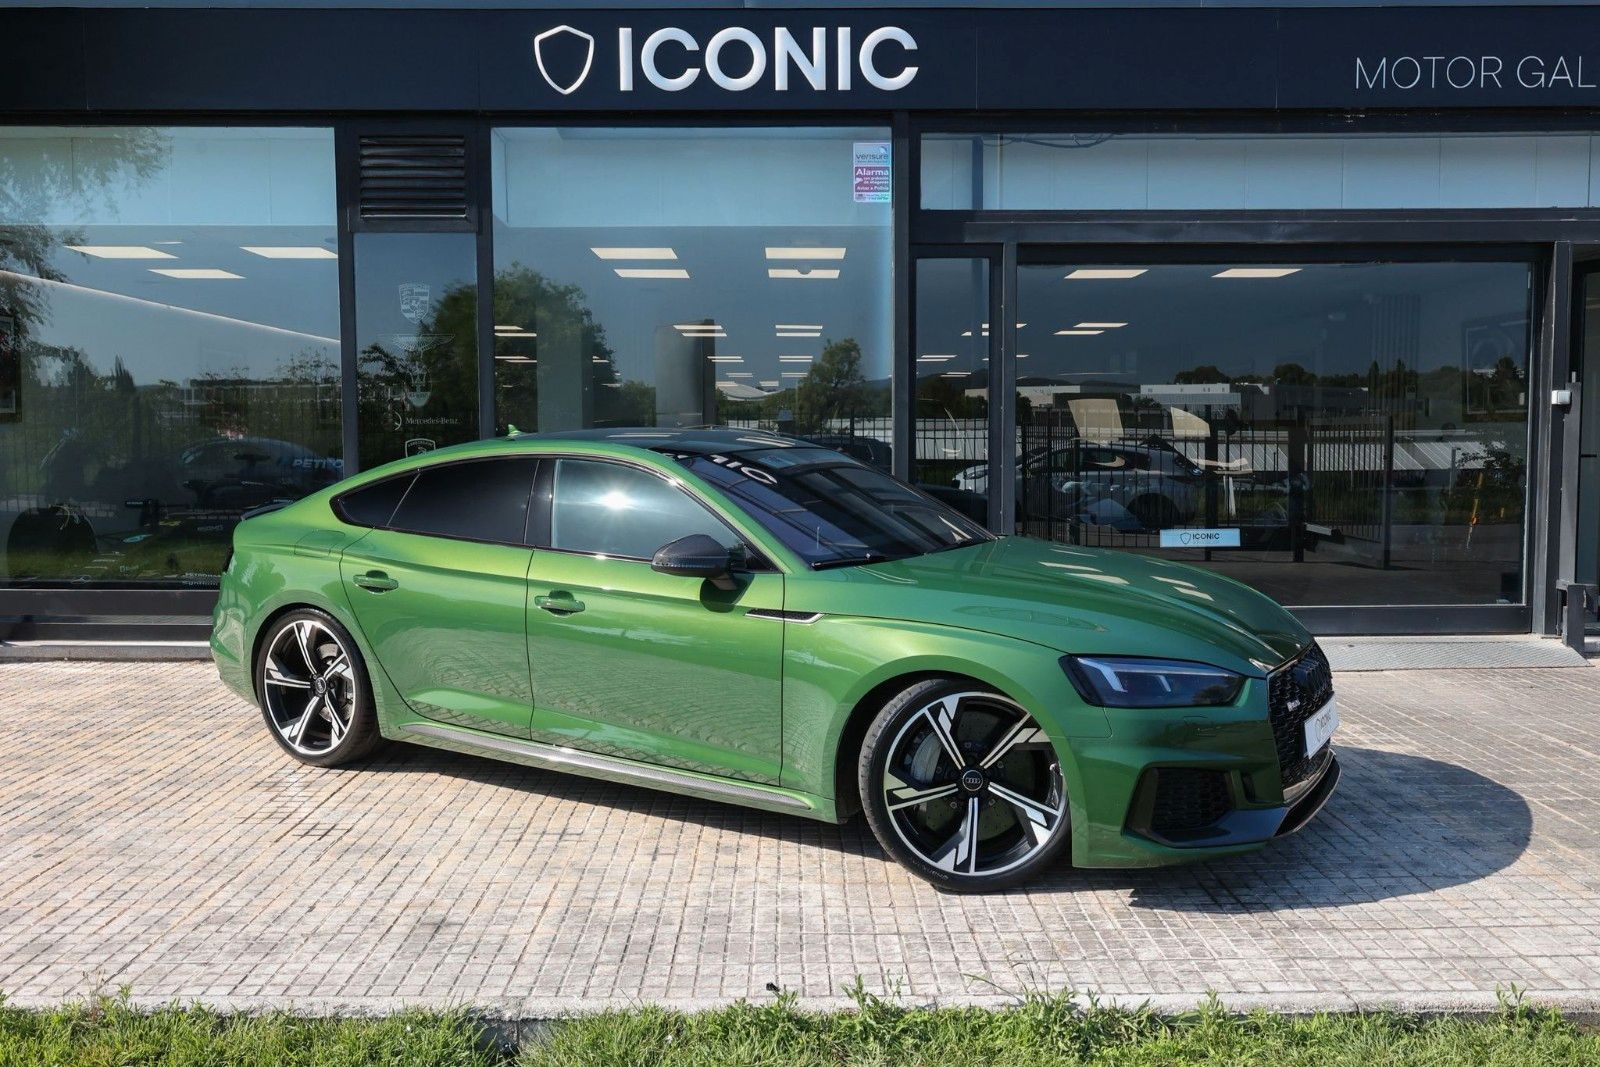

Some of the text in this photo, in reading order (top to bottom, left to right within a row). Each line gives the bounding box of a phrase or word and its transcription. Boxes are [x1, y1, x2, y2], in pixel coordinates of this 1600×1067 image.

[618, 26, 919, 92] ICONIC
[1355, 55, 1597, 89] MOTOR GAL
[405, 416, 458, 425] Mercedes-Benz
